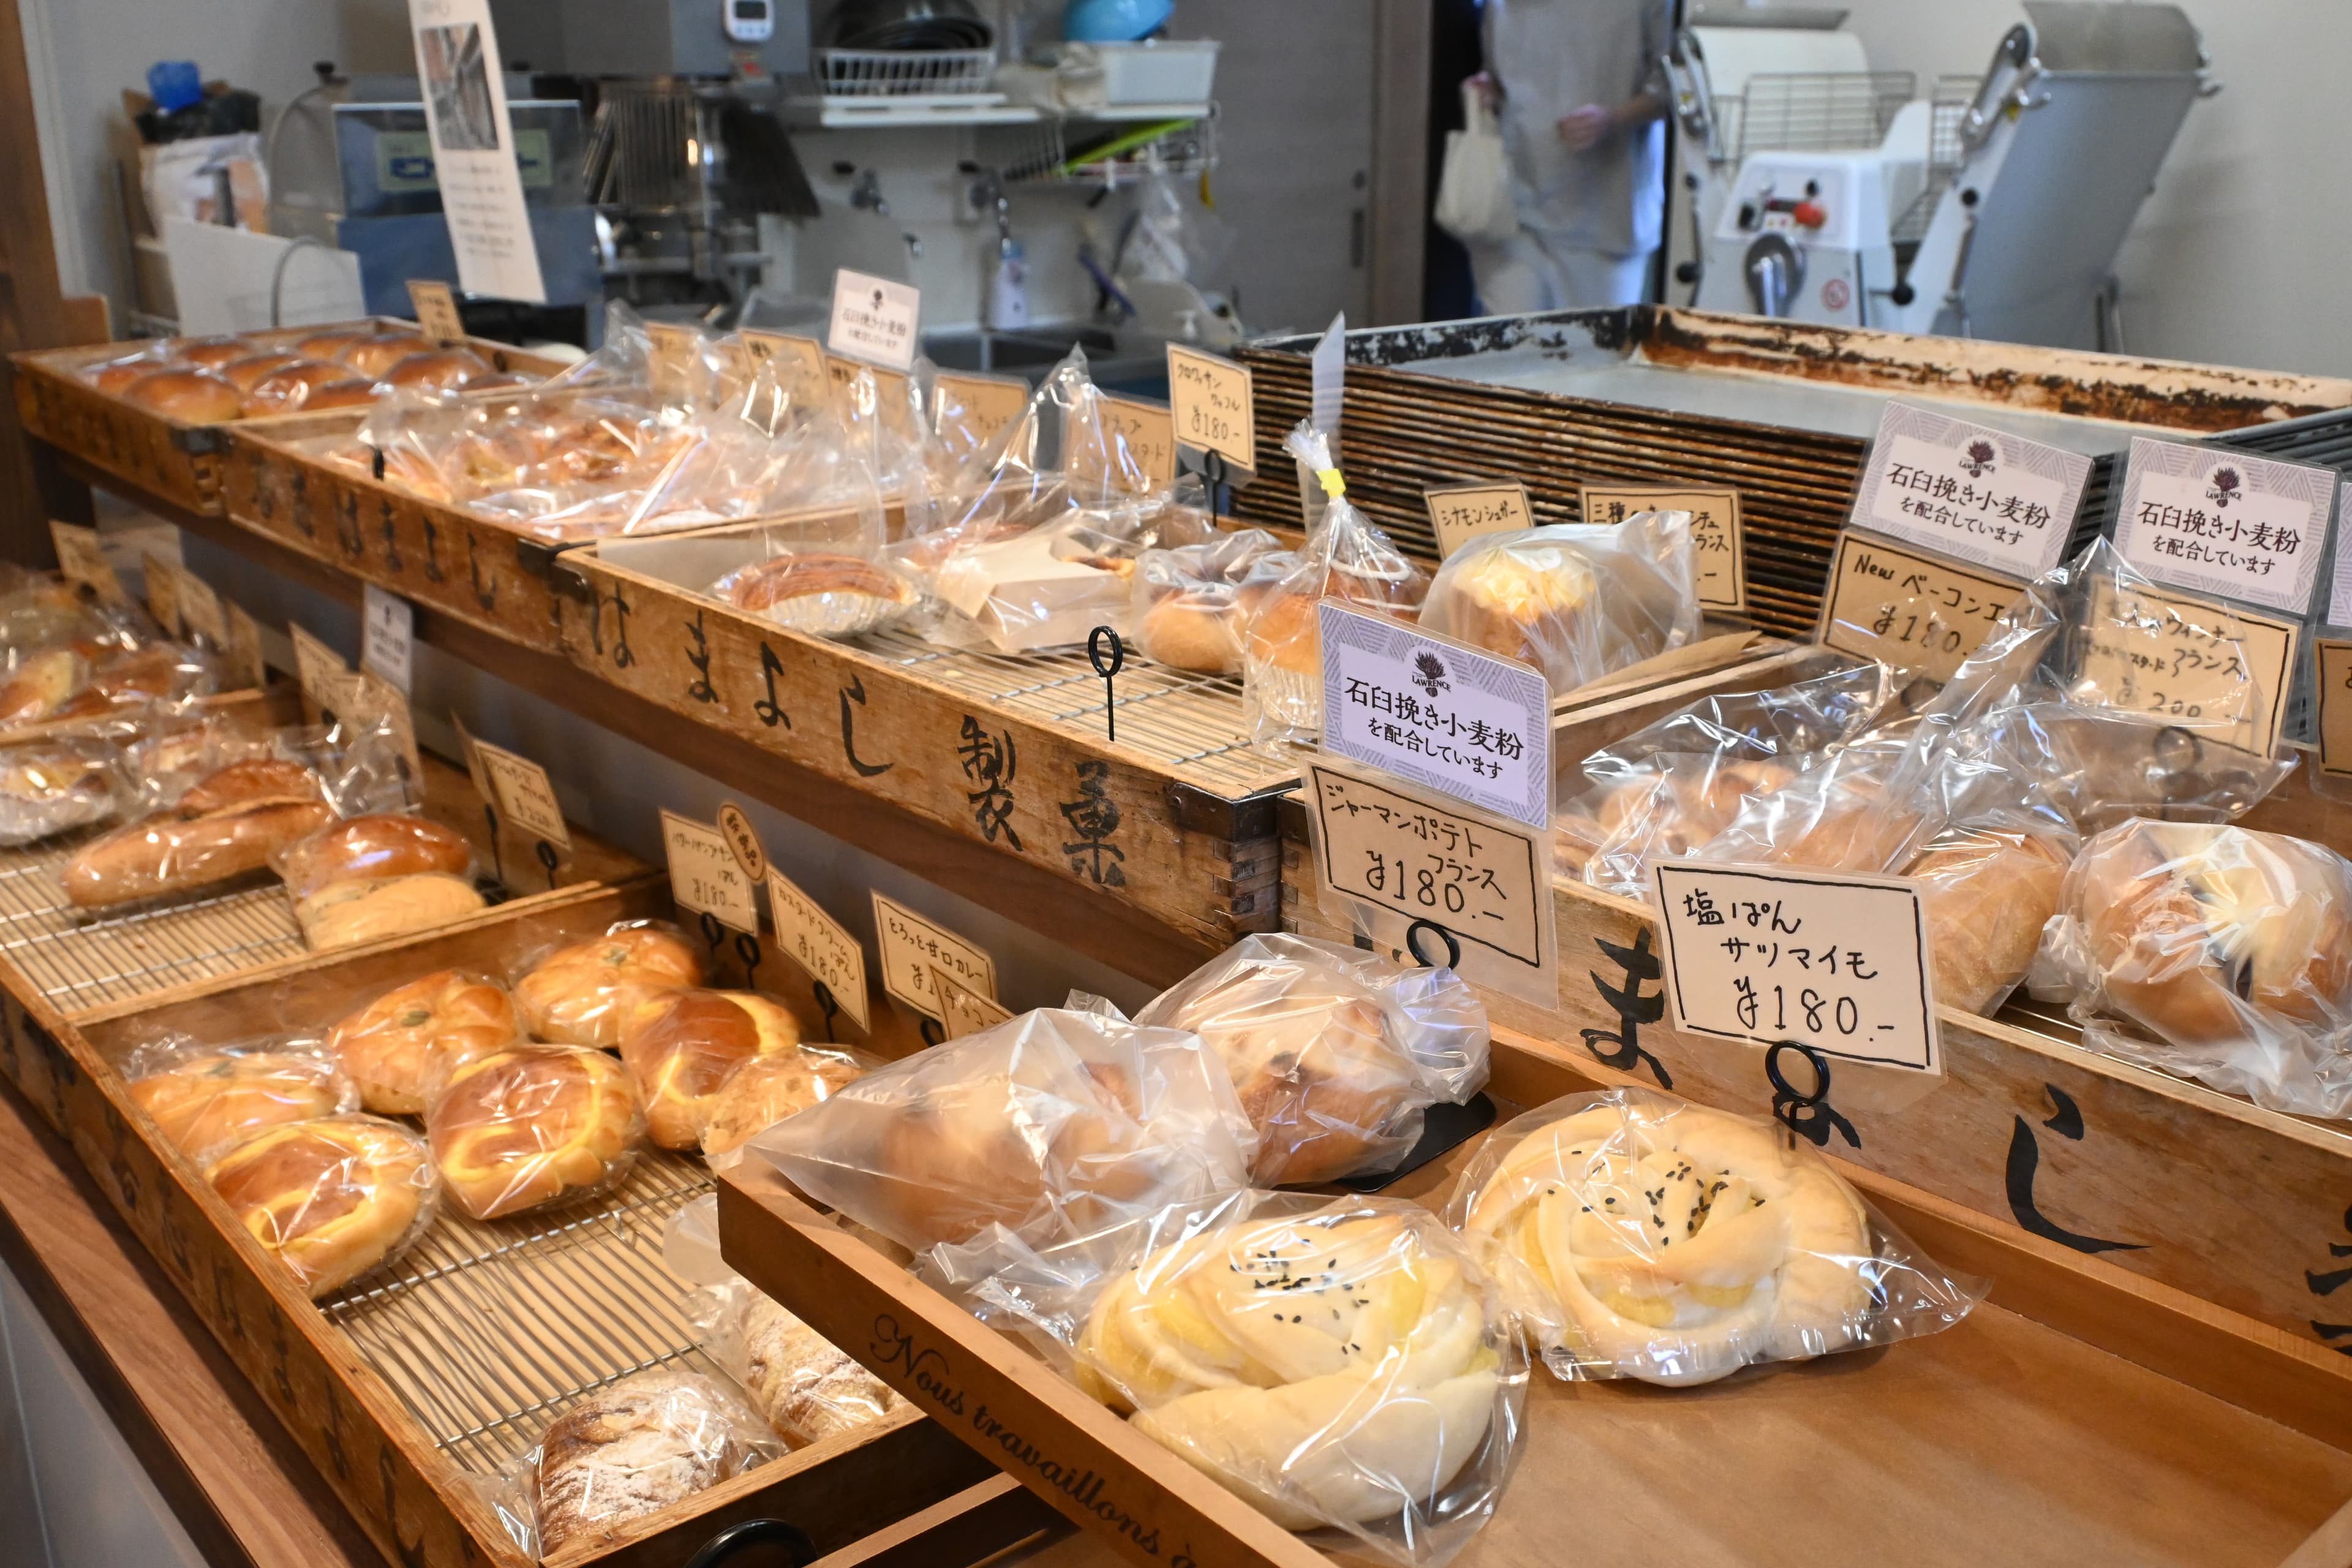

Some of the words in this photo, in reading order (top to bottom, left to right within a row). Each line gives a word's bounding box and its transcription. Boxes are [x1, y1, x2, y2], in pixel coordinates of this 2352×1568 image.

[1959, 461, 1997, 473] LAWRENCE
[1441, 500, 1518, 527] シナモンシュガー
[1887, 462, 2051, 530] 石臼挽き小麦粉
[2206, 489, 2242, 502] LAWRENCE
[1901, 496, 2025, 546] を配合しています
[2137, 501, 2302, 555] 石臼挽き小麦粉
[2152, 534, 2275, 575] を配合しています
[1853, 553, 1895, 581] New
[1901, 575, 2014, 623] ベーコンエ
[1411, 674, 1452, 693] LAWRENCE
[1343, 676, 1525, 761] 石臼挽き小麦粉
[1367, 717, 1504, 780] を配合しています
[1326, 783, 1484, 859] ジャーマンポテト
[1428, 853, 1507, 901] フランス
[1683, 888, 1802, 935] 塩ぱん
[889, 917, 983, 979] とろっと甘口カレー
[1721, 937, 1879, 980] サツマイモ
[869, 1314, 965, 1417] Nous
[974, 1404, 1161, 1556] travaillons
